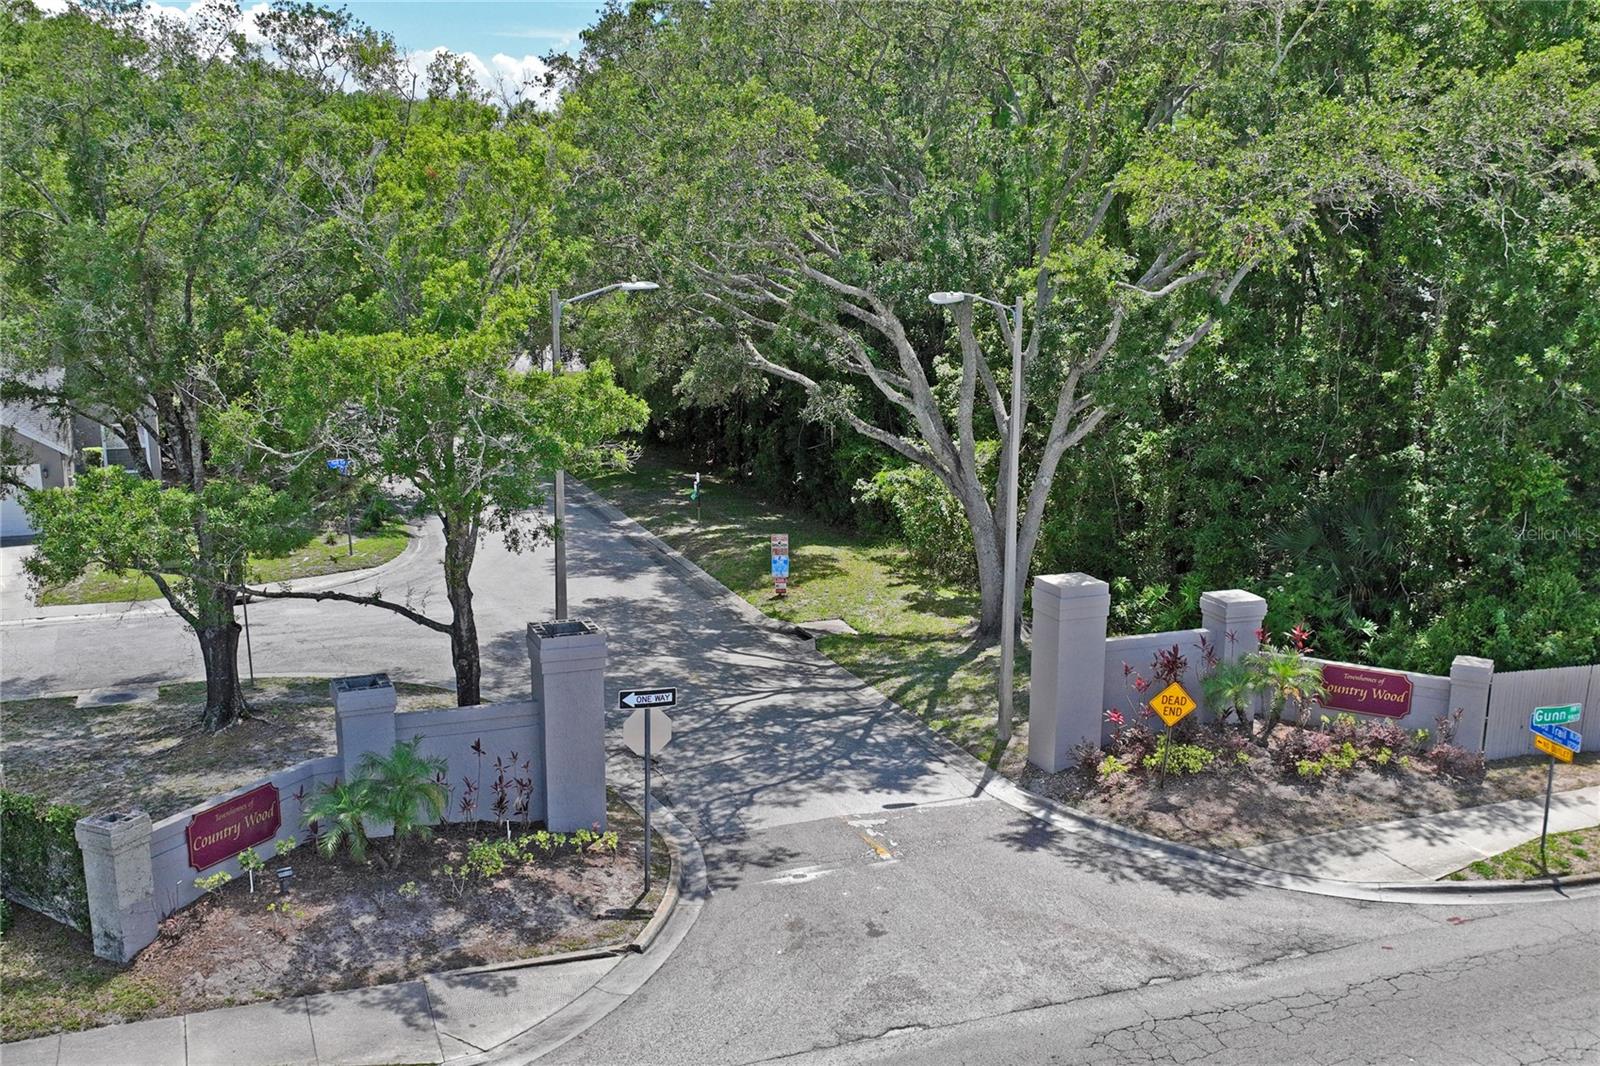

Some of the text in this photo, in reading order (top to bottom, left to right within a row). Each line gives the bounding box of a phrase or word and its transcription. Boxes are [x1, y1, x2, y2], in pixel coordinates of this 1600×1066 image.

[1344, 673, 1386, 687] Townhomes of
[636, 693, 671, 703] ONE WAY
[1161, 695, 1187, 706] DEAD
[1372, 688, 1409, 703] Wood
[1163, 706, 1182, 717] END
[1535, 709, 1567, 722] Gunn
[193, 801, 277, 852] Country Wood
